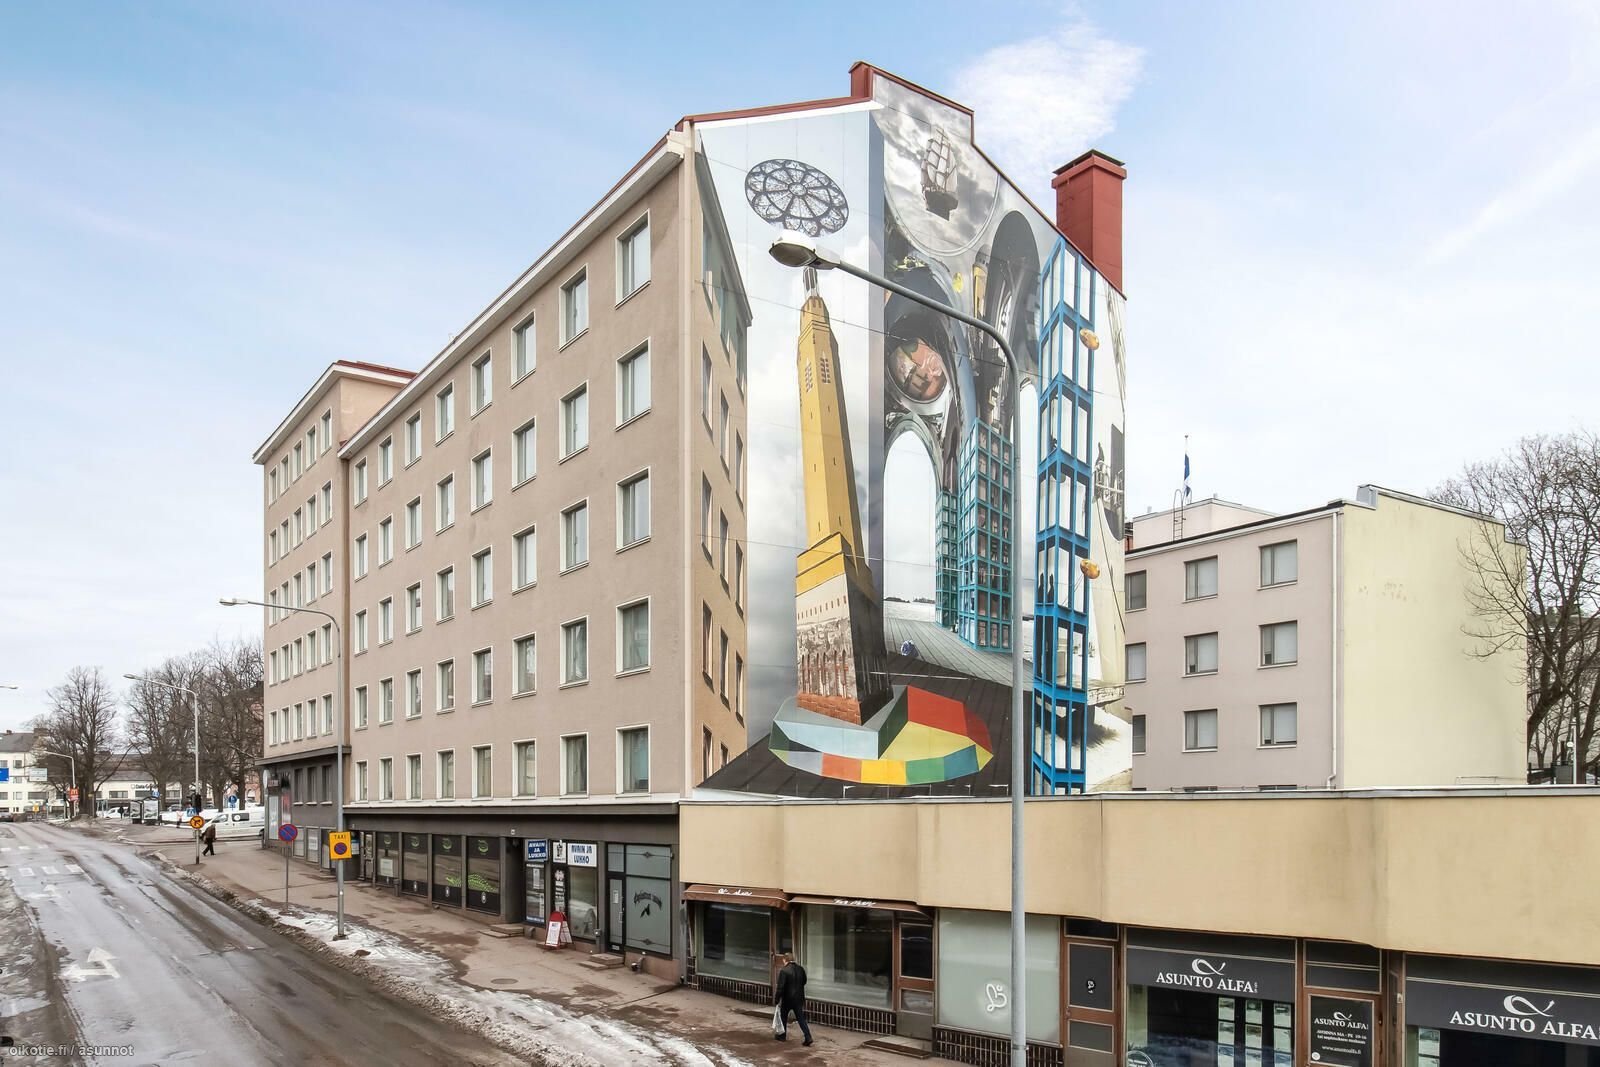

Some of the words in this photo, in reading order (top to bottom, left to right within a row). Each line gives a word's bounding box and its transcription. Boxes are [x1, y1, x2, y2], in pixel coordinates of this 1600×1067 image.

[586, 846, 592, 854] JA
[1156, 972, 1214, 989] ASUNTO
[1217, 978, 1254, 993] ALFA
[1314, 1018, 1345, 1027] ASUNTO
[1450, 1011, 1536, 1033] ASUNTO
[1541, 1020, 1598, 1040] ALFA
